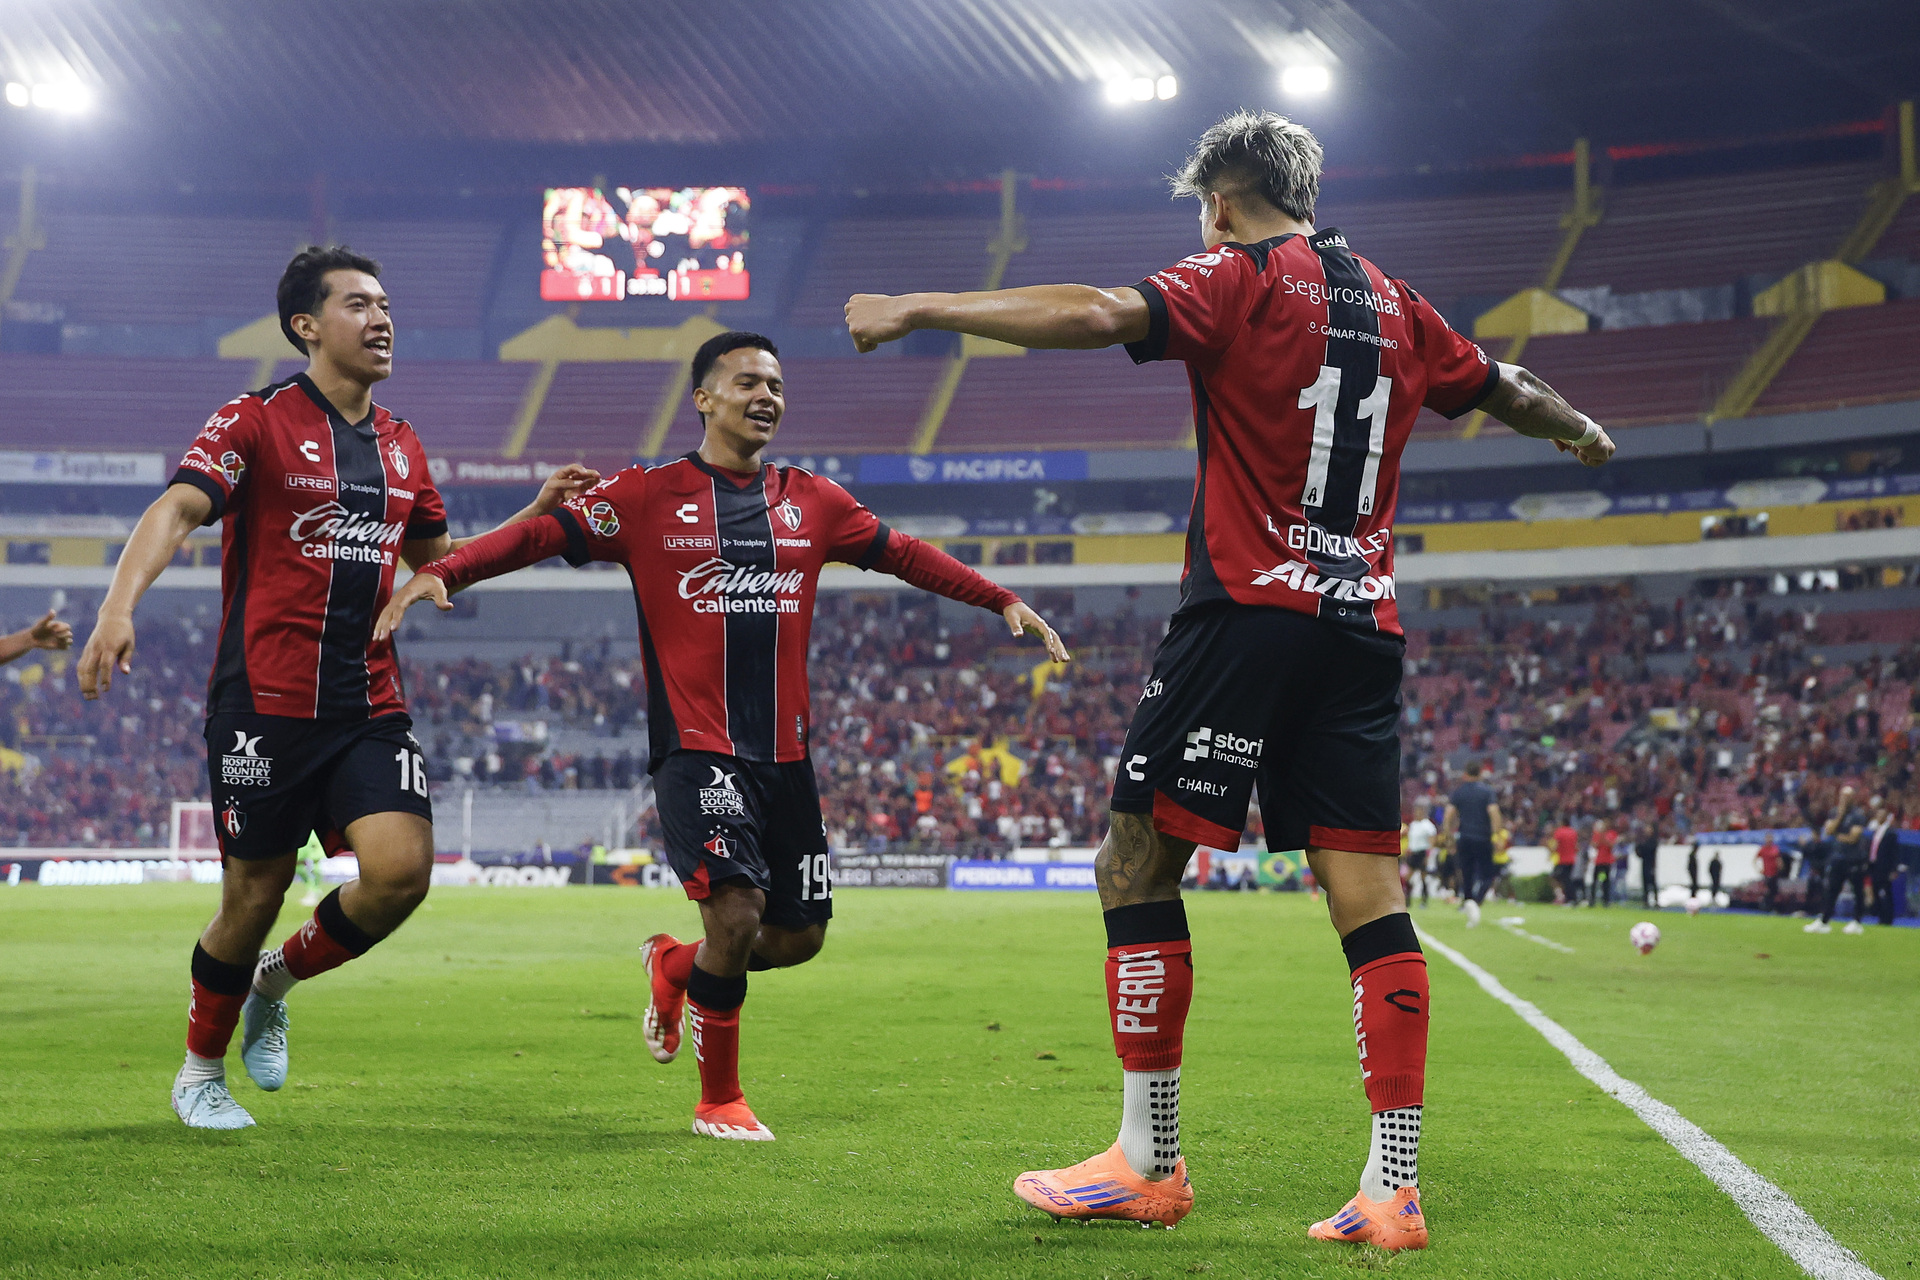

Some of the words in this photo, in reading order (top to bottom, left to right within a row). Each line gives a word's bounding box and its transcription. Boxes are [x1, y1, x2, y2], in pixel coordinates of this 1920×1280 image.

[1282, 274, 1400, 317] SegurosAtlas
[1320, 324, 1356, 340] GANAR
[1357, 331, 1398, 350] SIRVIENDO
[1298, 365, 1392, 515] 11
[942, 458, 1045, 480] PACIFICA
[288, 476, 332, 490] URREA
[350, 483, 381, 496] Totalplay
[667, 538, 713, 548] URREA
[733, 538, 768, 548] Totalplay
[776, 538, 812, 547] PERDURA
[676, 556, 805, 600] Caliente
[692, 595, 800, 614] caliente.mx
[1214, 732, 1264, 757] stori
[222, 757, 272, 769] HOSPITAL
[1212, 750, 1260, 769] finanzas
[222, 766, 272, 777] COUNTRY
[395, 747, 429, 798] 16
[1177, 777, 1228, 797] CHARLY
